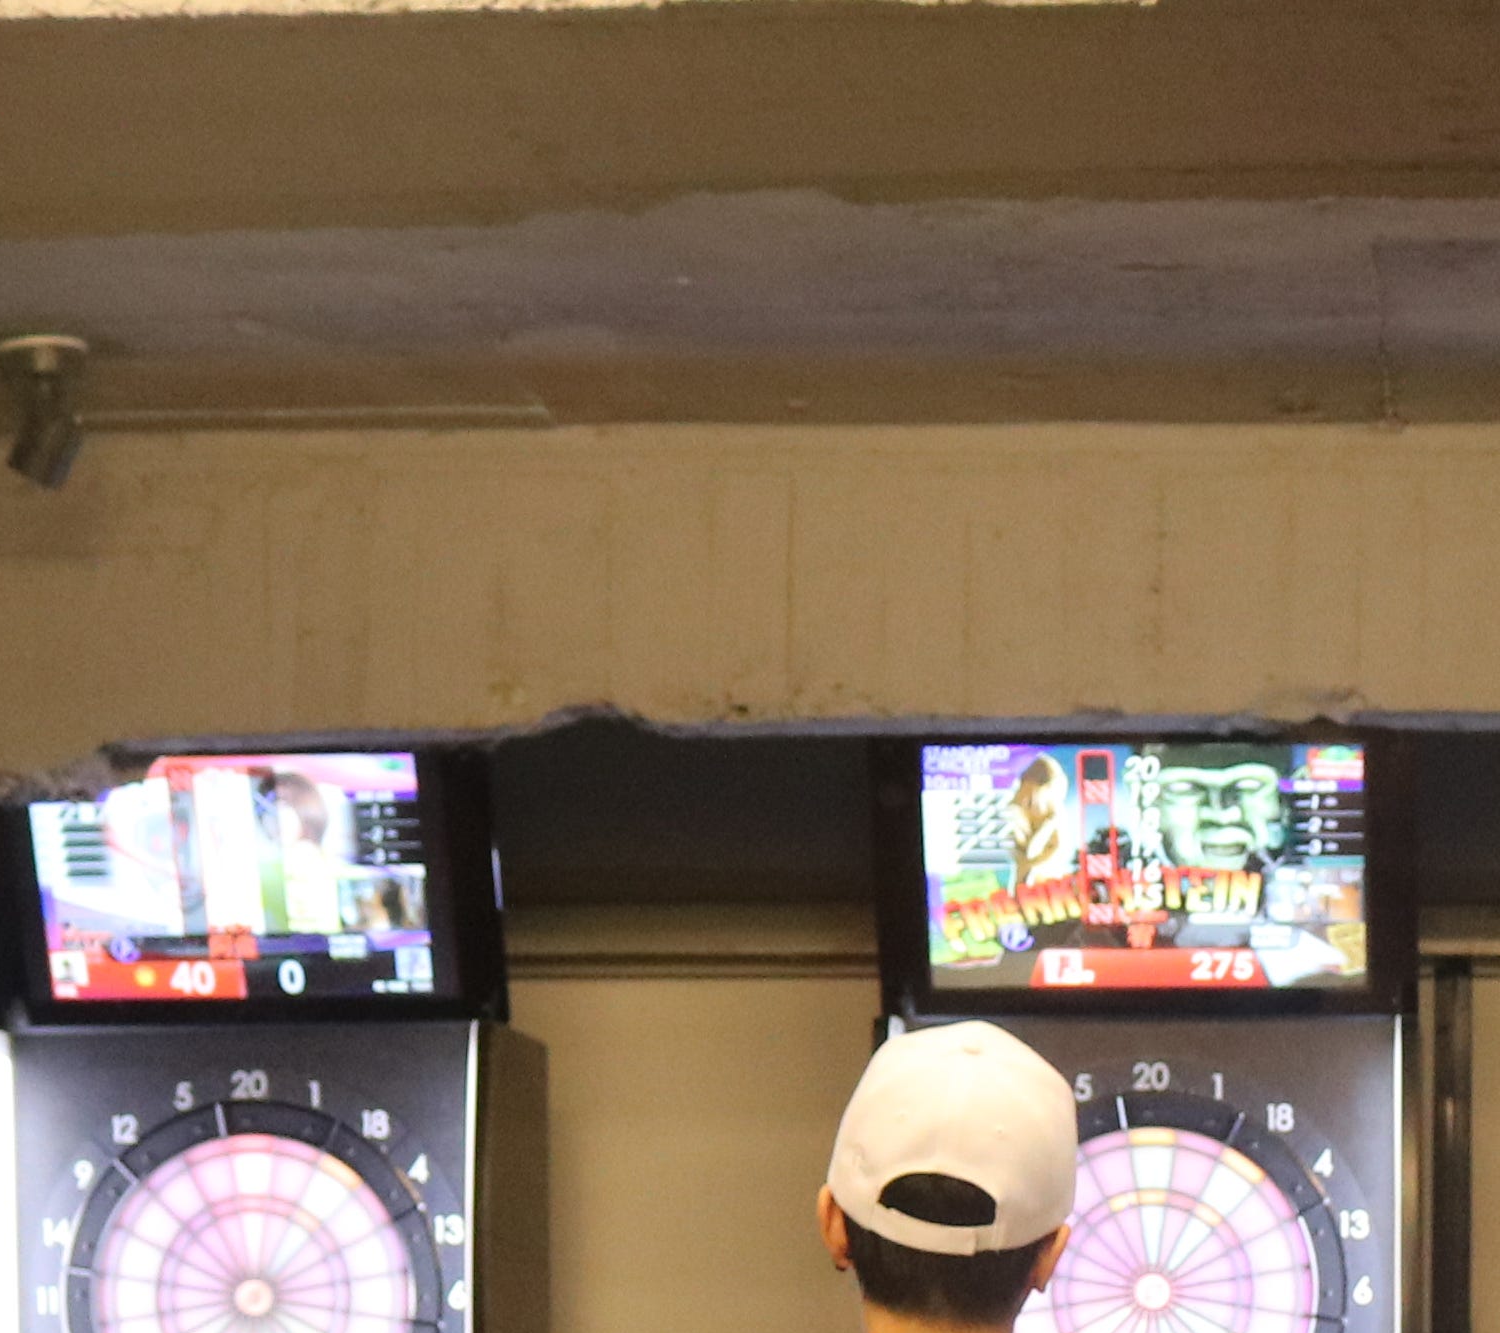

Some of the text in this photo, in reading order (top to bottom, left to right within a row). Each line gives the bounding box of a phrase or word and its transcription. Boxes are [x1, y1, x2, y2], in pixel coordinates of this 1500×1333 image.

[1123, 754, 1161, 781] 20
[169, 960, 307, 996] 40 0
[1189, 951, 1255, 981] 275
[232, 1071, 267, 1098] 20
[1074, 1075, 1091, 1101] 5
[1134, 1063, 1169, 1089] 20
[1215, 1074, 1222, 1099] 1
[175, 1083, 192, 1109] 5
[311, 1082, 319, 1106] 1
[113, 1116, 136, 1143] 12
[364, 1111, 388, 1137] 18
[1268, 1104, 1293, 1131] 18
[75, 1161, 93, 1188] 9
[409, 1155, 429, 1183] 4
[1314, 1149, 1333, 1177] 4
[44, 1218, 70, 1246] 14
[436, 1216, 465, 1242] 13
[1341, 1210, 1369, 1239] 13
[38, 1288, 58, 1313] 11
[448, 1279, 468, 1307] 6
[1353, 1277, 1372, 1304] 6
